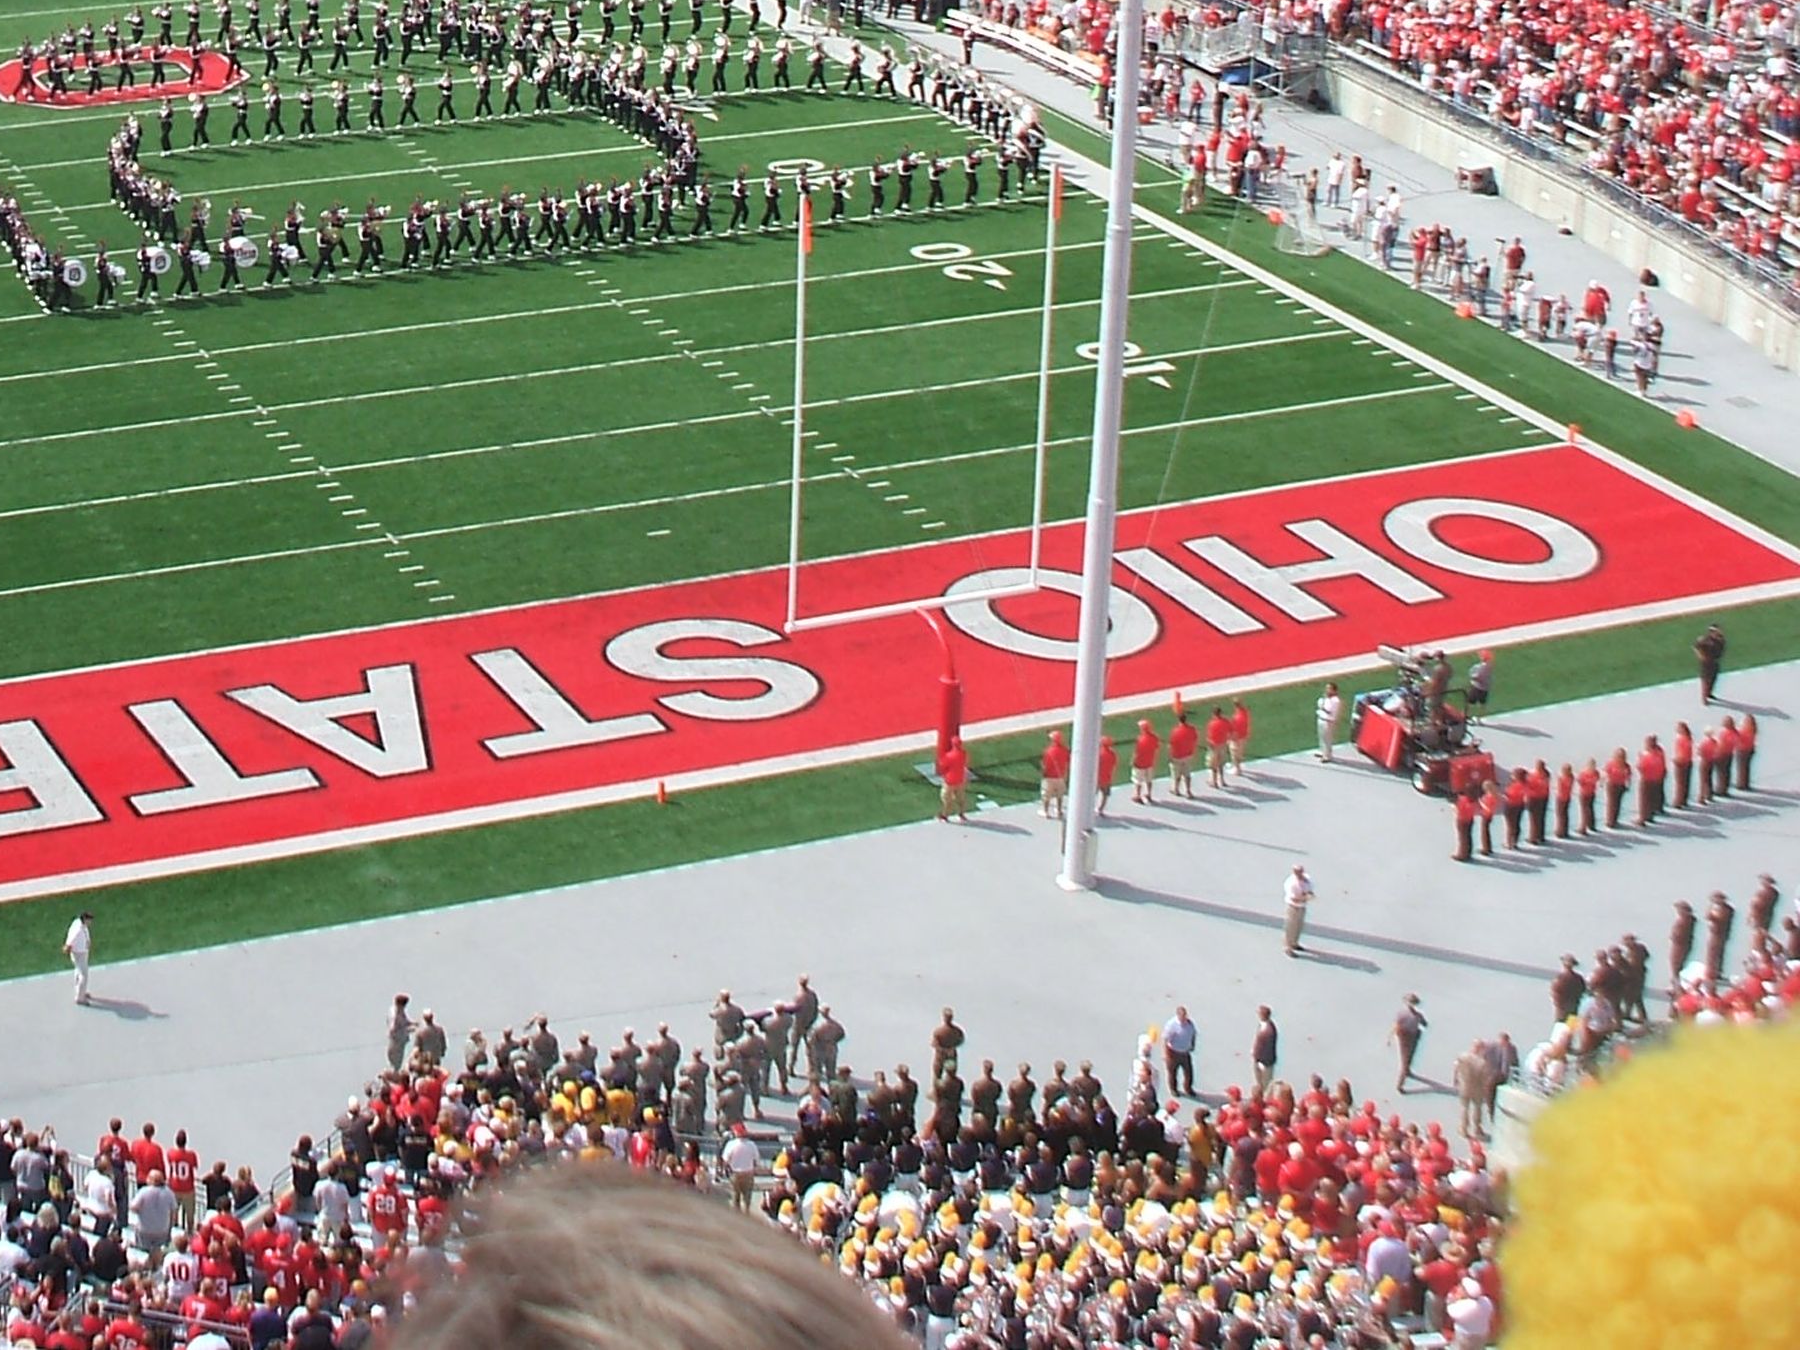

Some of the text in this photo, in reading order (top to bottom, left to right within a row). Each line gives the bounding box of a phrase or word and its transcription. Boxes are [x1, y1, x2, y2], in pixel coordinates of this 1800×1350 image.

[910, 242, 1014, 281] 20
[943, 497, 1602, 662] OHIO
[170, 1161, 190, 1180] 10
[170, 1262, 191, 1282] 10
